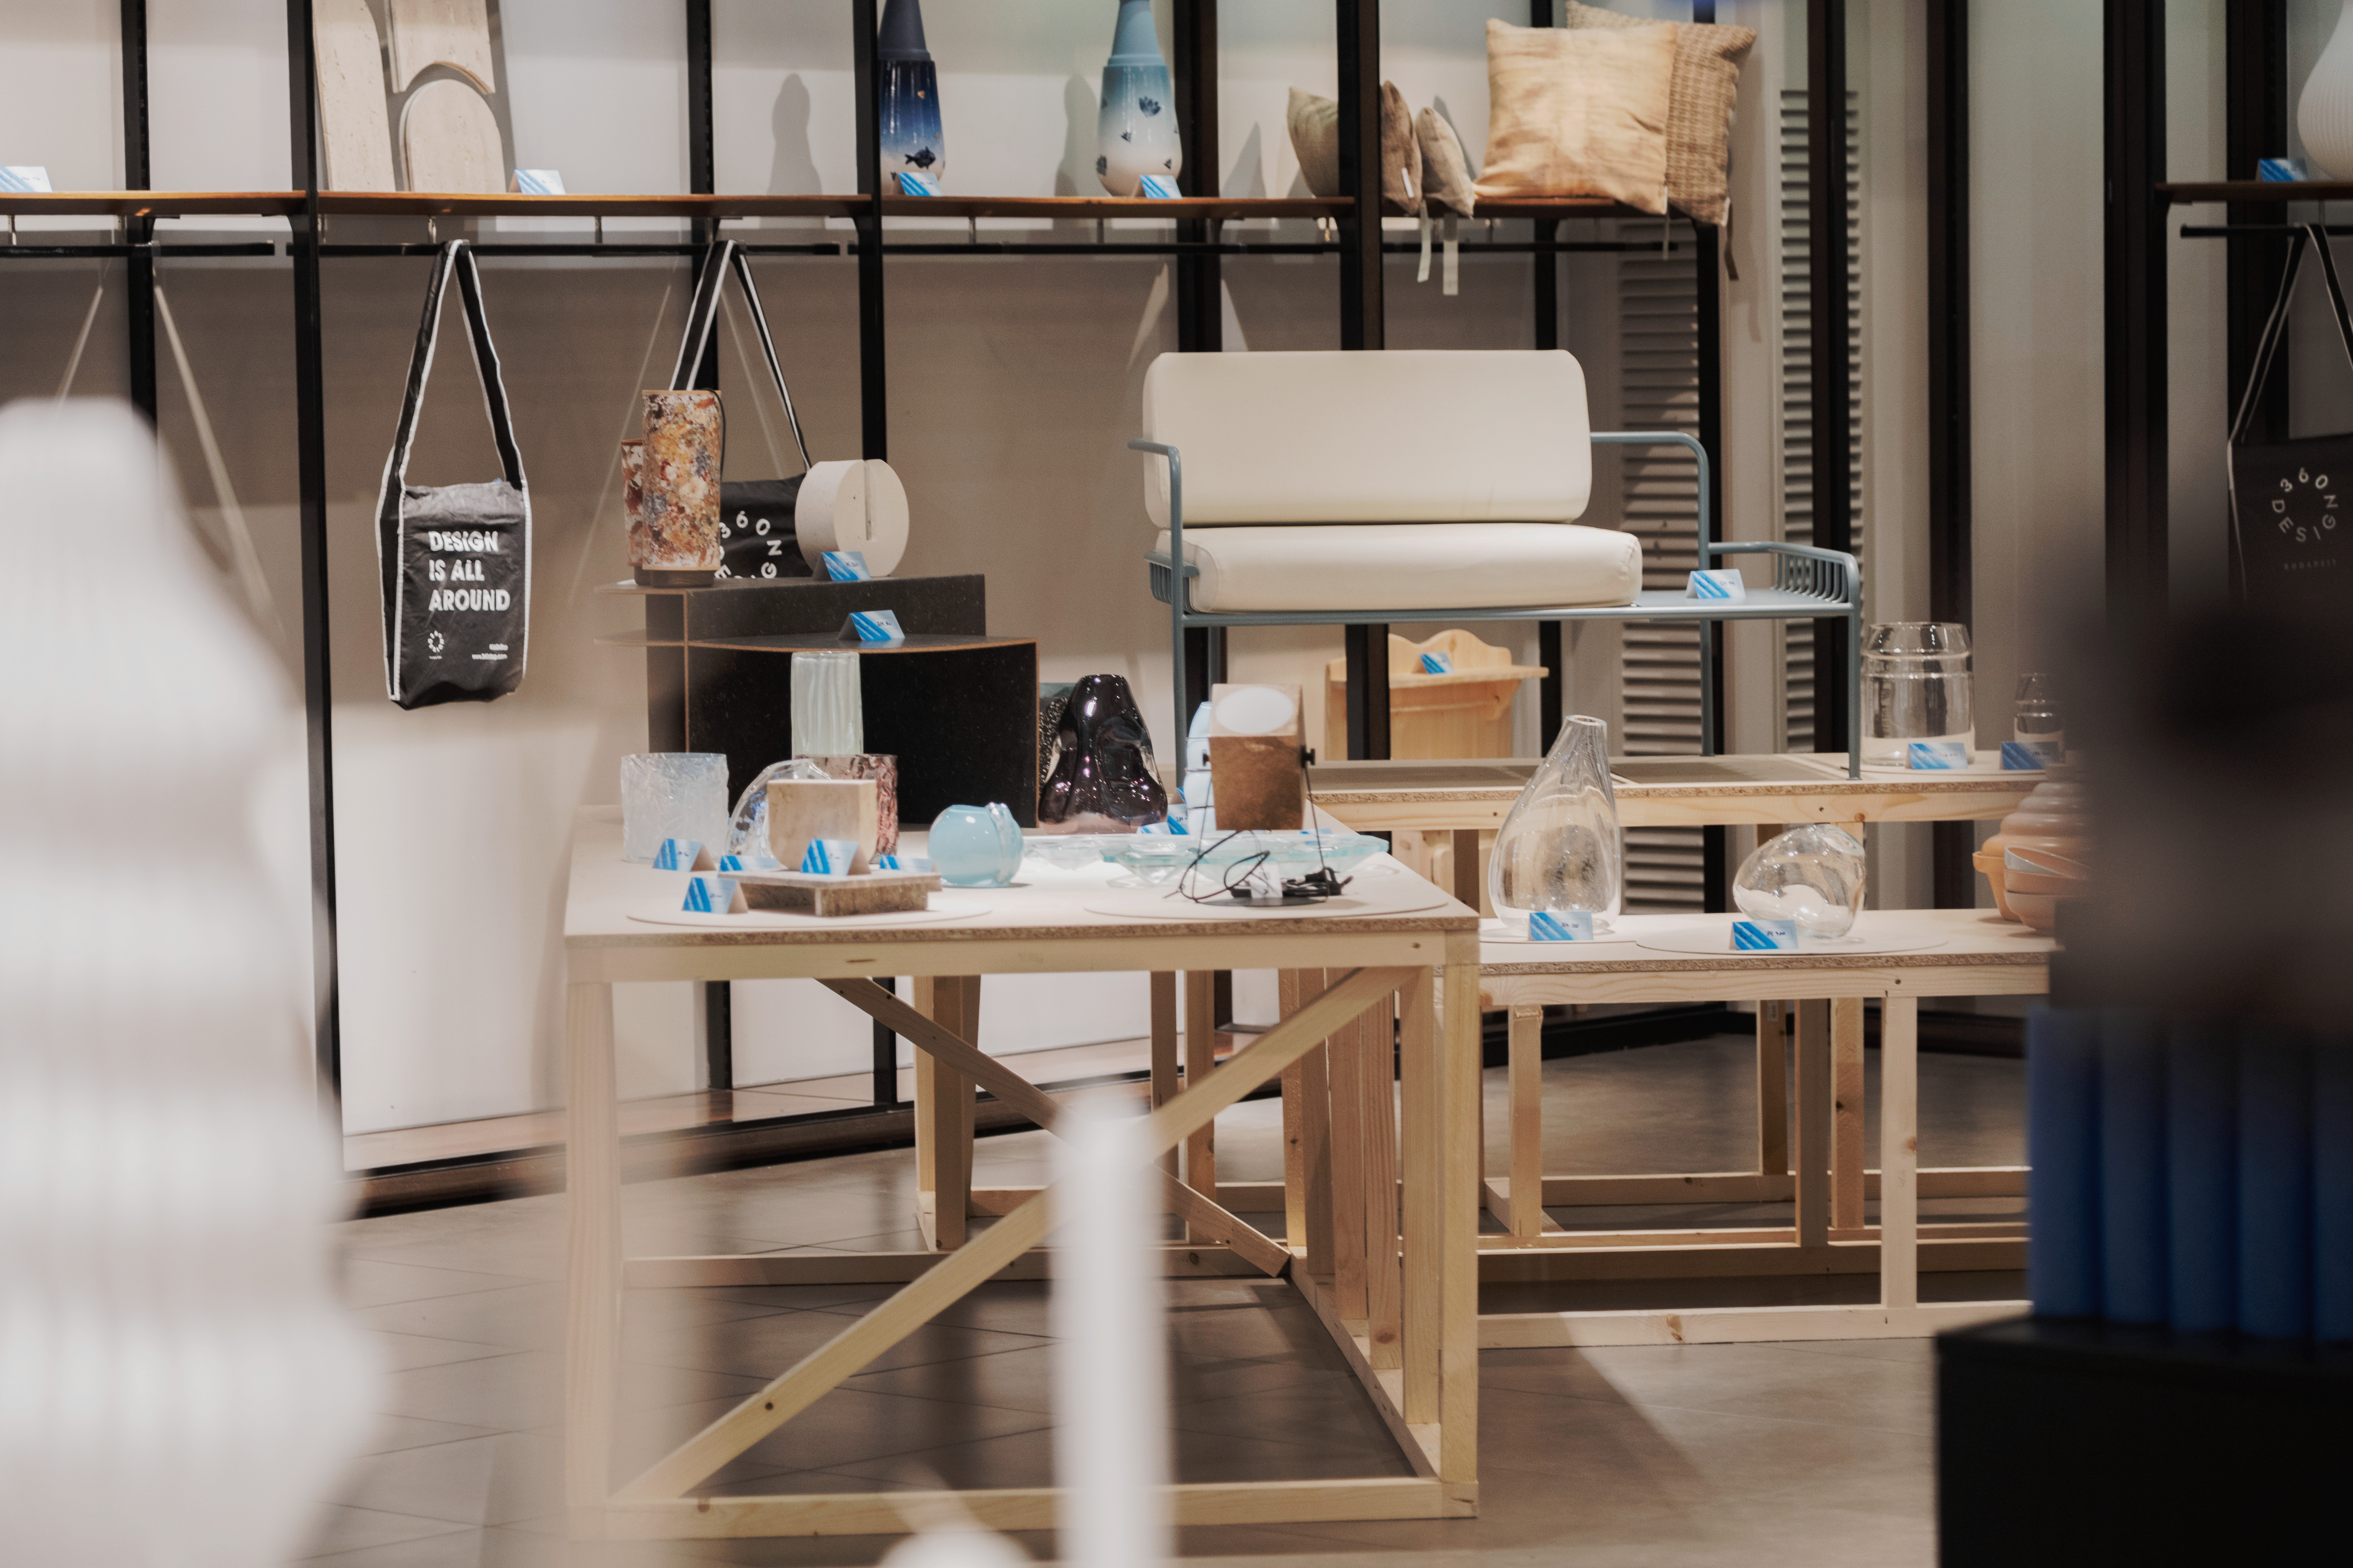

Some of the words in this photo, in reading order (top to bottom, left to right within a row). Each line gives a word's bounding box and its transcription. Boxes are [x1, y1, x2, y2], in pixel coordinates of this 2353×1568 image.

[2280, 467, 2328, 492] 360
[719, 511, 770, 538] 360
[2272, 494, 2338, 542] DESIGN
[428, 531, 499, 552] DESIGN
[429, 559, 446, 581] IS
[451, 559, 484, 581] ALL
[428, 589, 510, 611] AROUND
